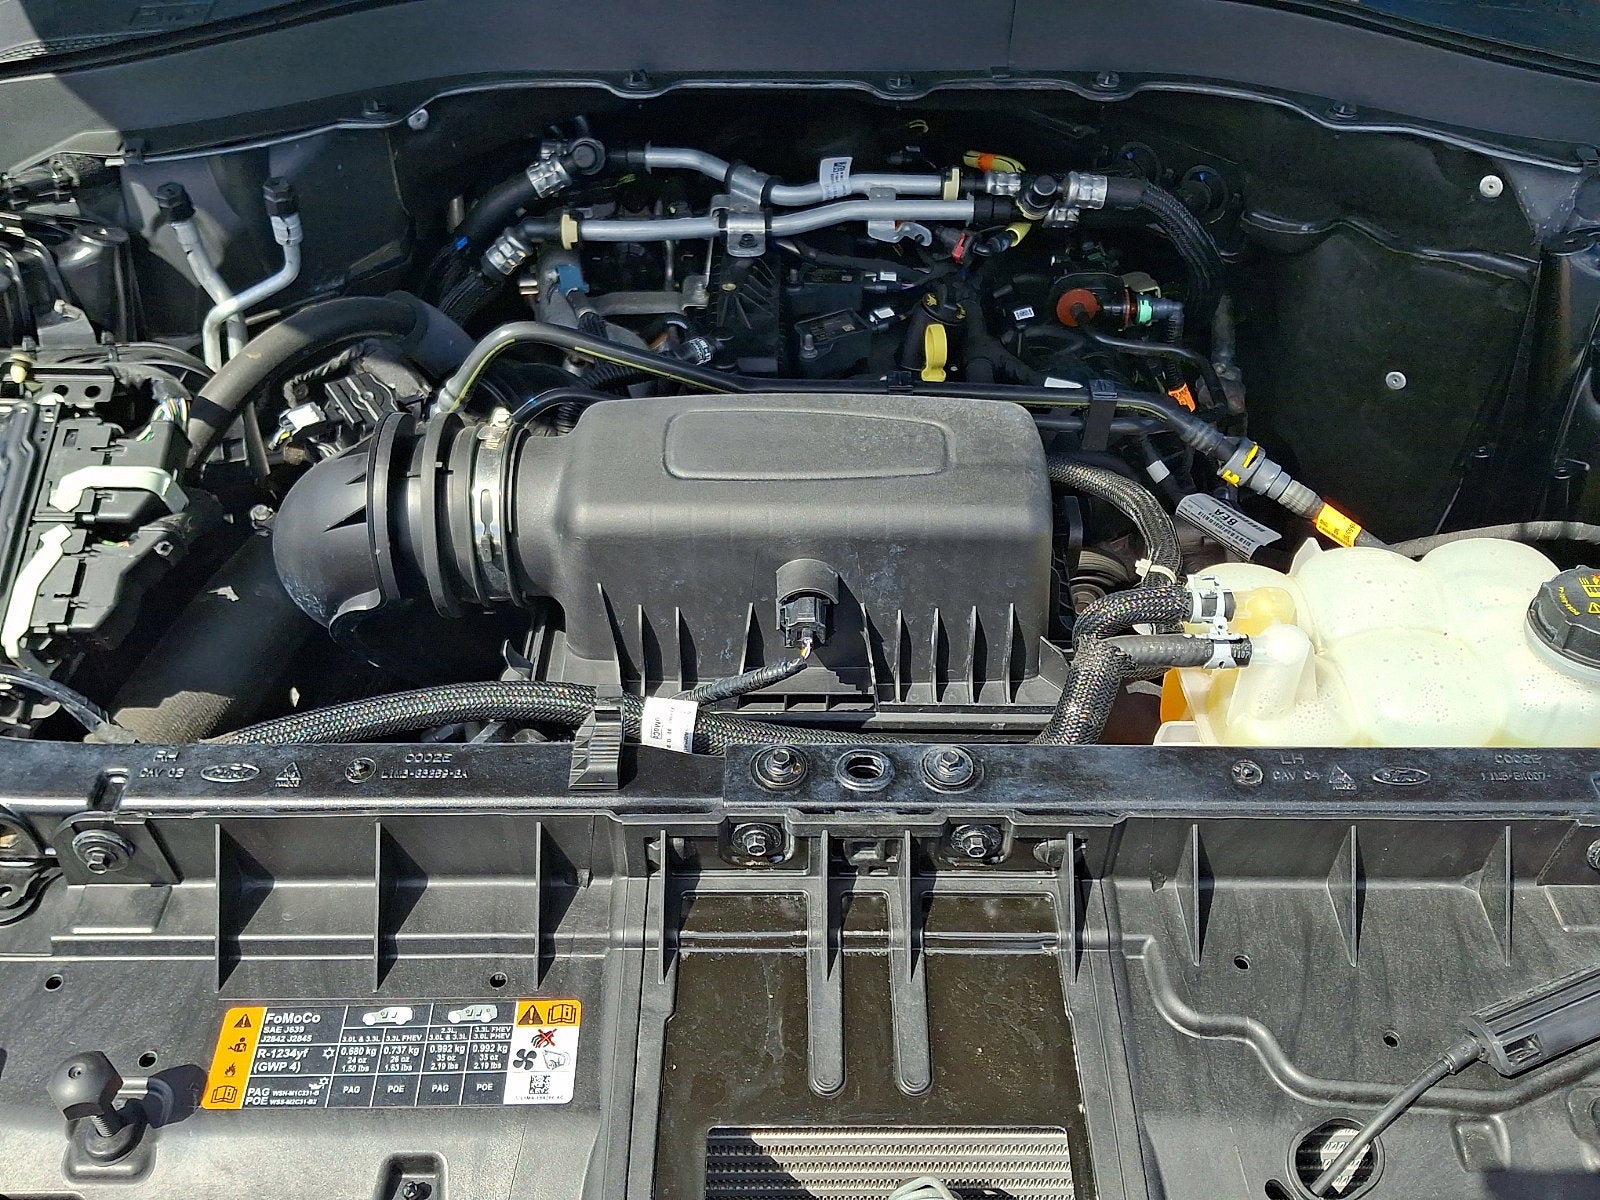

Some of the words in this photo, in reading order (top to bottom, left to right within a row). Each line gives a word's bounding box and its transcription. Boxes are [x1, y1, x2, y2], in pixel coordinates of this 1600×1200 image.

[1214, 508, 1239, 526] BEA
[264, 1012, 321, 1024] FoMoCo
[262, 1026, 283, 1034] SAE
[283, 1026, 305, 1034] J639
[260, 1035, 286, 1043] J2842
[286, 1035, 313, 1043] J2845
[402, 1034, 423, 1042] FHEV
[340, 1046, 364, 1056] 0.680
[365, 1046, 377, 1057] kg
[383, 1045, 406, 1055] 0.737
[408, 1045, 420, 1057] kg
[429, 1044, 453, 1054] 0.992
[454, 1044, 466, 1055] kg
[472, 1043, 496, 1053] 0.992
[497, 1043, 508, 1054] kg
[257, 1048, 309, 1060] R-1234yf
[436, 1053, 446, 1061] 35
[479, 1053, 490, 1061] 35
[346, 1056, 357, 1064] 24
[253, 1061, 288, 1074] (GWP
[289, 1061, 301, 1074] 4)
[342, 1064, 357, 1073] 1.50
[357, 1064, 370, 1072] lbs
[384, 1063, 400, 1072] 1.63
[400, 1063, 413, 1071] lbs
[430, 1062, 447, 1071] 2.19
[447, 1062, 459, 1070] lbs
[473, 1062, 490, 1070] 2.19
[490, 1062, 502, 1070] lbs
[247, 1087, 271, 1097] PAG
[342, 1085, 361, 1094] PAG
[386, 1084, 406, 1093] POE
[431, 1084, 450, 1093] PAG
[476, 1083, 494, 1092] POE
[244, 1096, 269, 1106] POE
